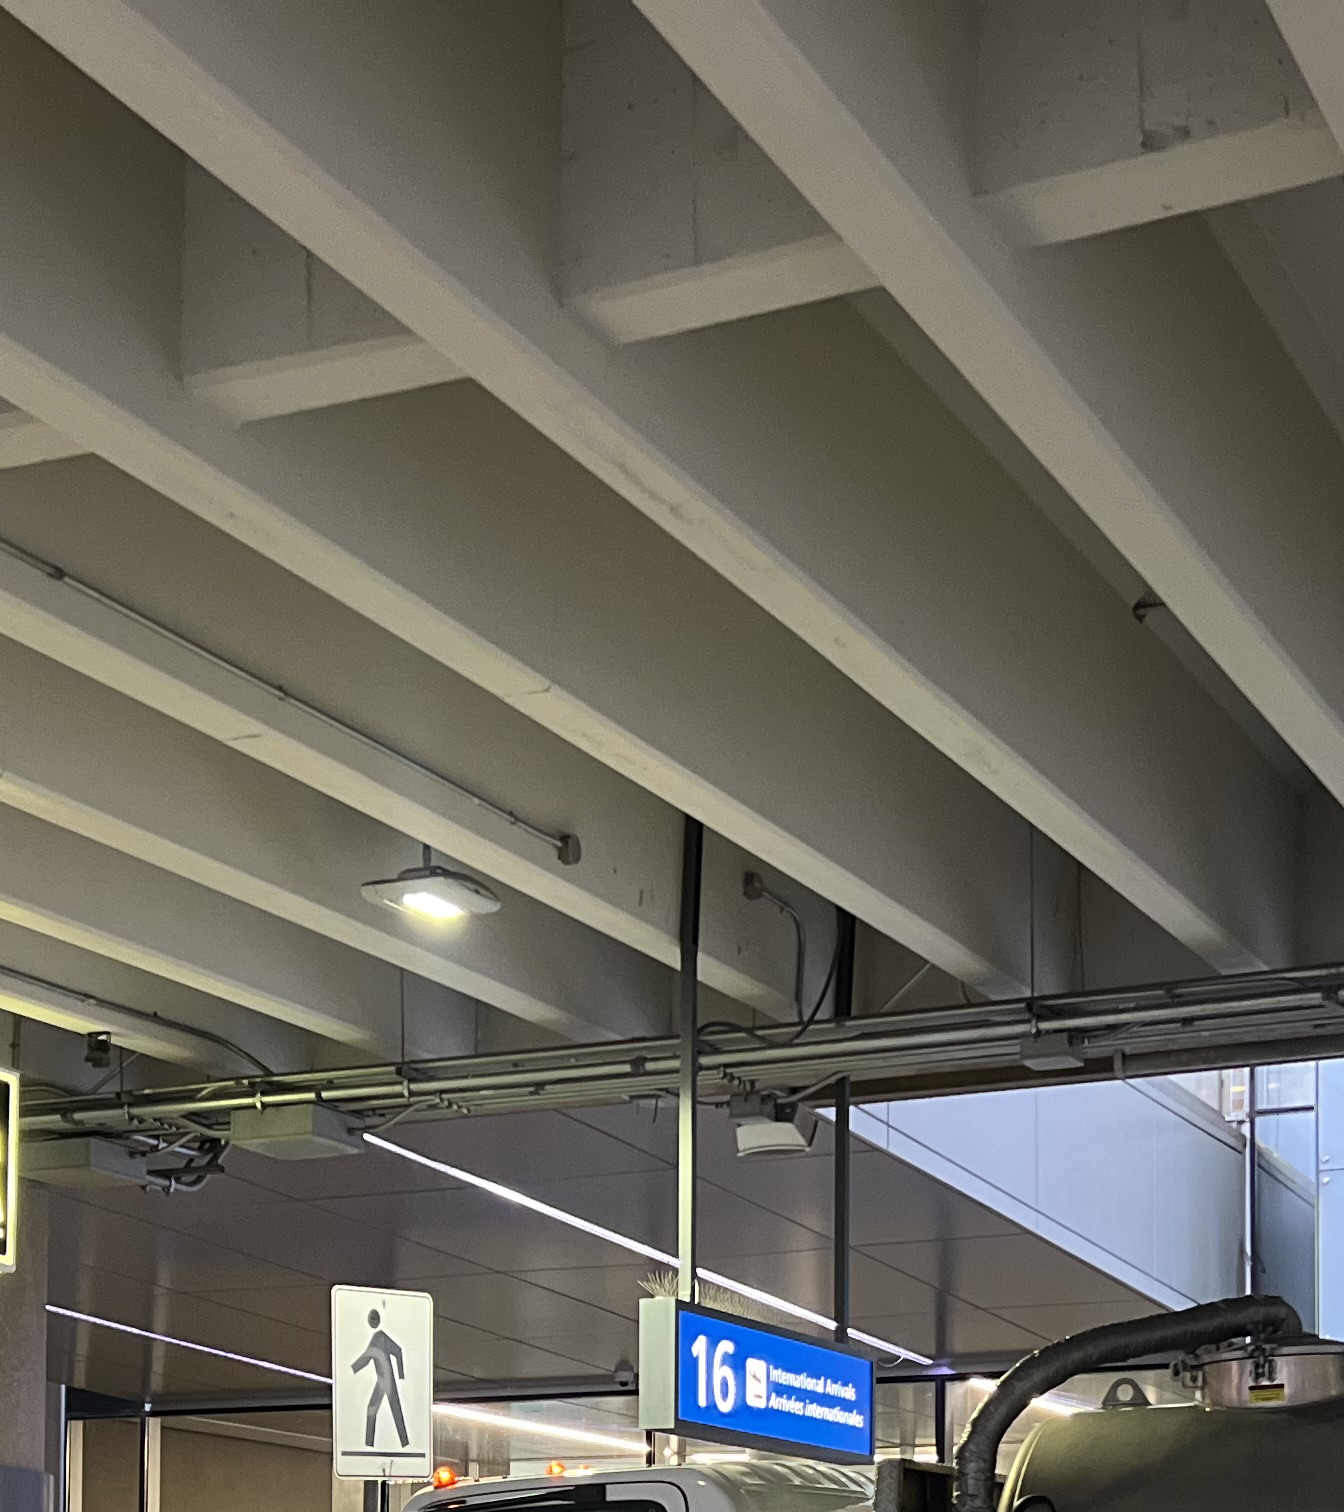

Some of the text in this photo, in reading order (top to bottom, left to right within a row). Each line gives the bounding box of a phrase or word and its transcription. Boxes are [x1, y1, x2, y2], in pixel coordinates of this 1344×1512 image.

[691, 1334, 736, 1413] 16
[769, 1364, 856, 1401] International Arrivals
[768, 1392, 864, 1428] Arrivées internationales
